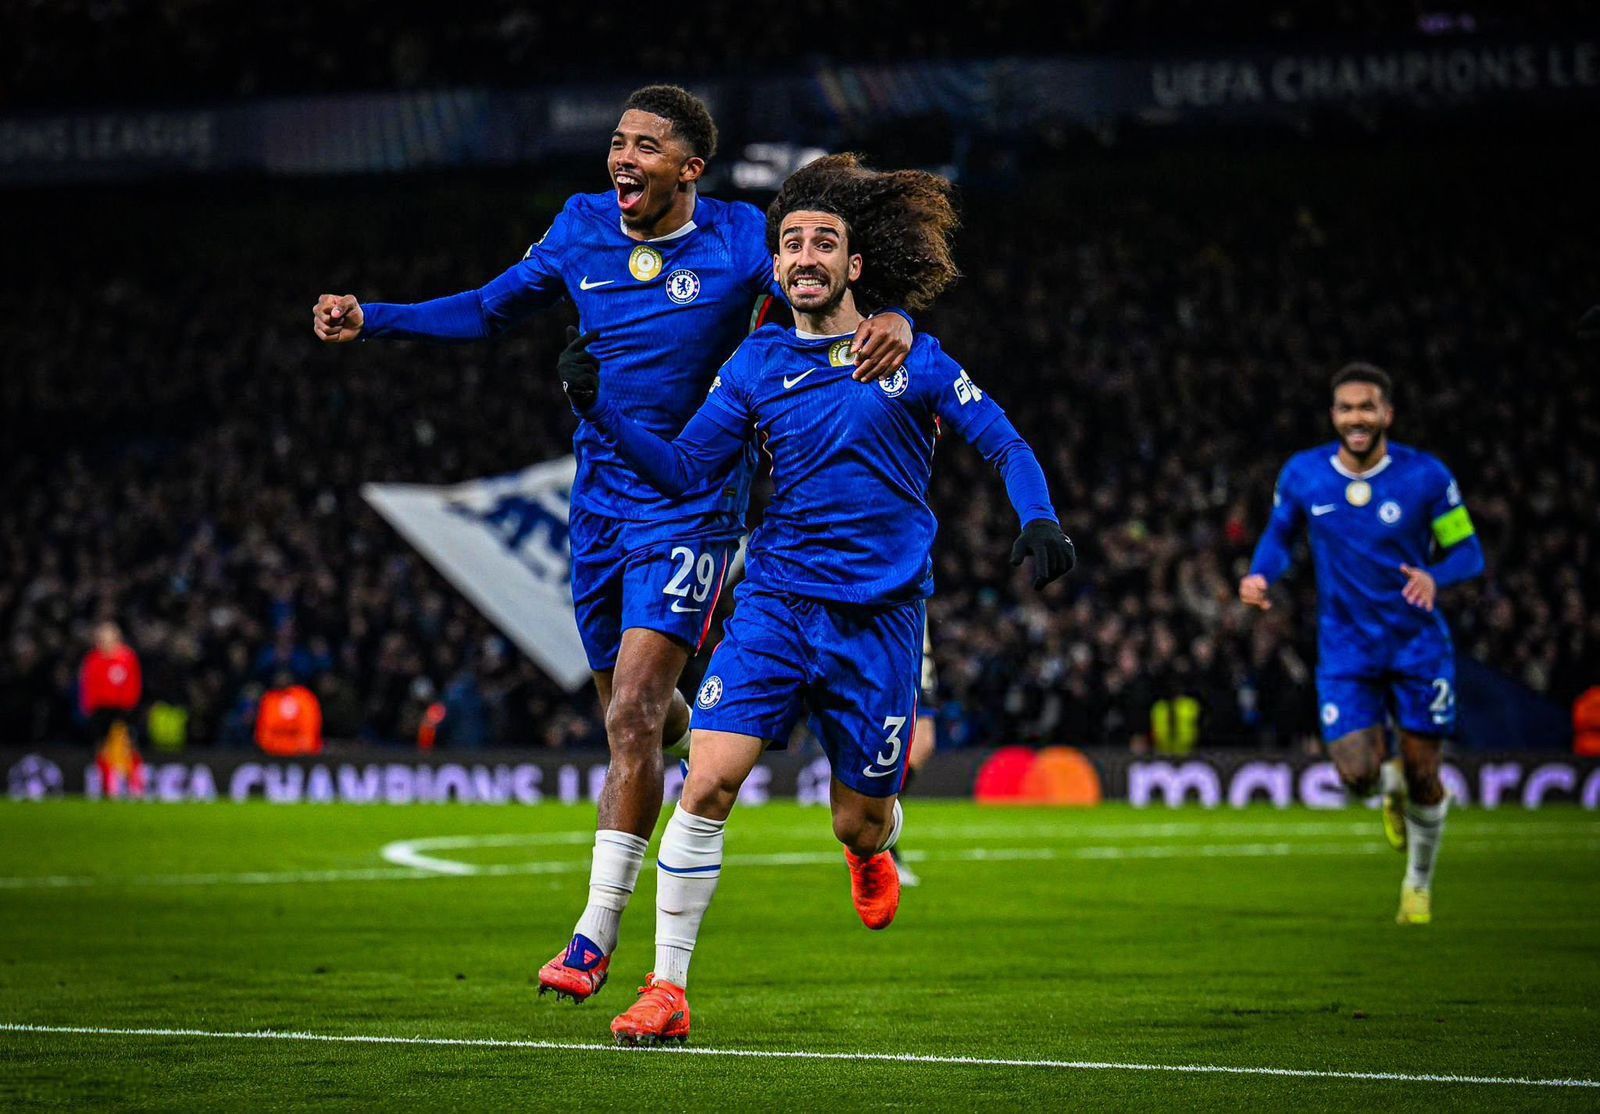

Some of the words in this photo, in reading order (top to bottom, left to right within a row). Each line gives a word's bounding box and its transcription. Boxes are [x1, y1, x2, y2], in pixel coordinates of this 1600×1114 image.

[1151, 60, 1263, 107] UEFA
[1270, 44, 1539, 101] CHAMPIONS
[662, 546, 715, 603] 29
[876, 716, 906, 766] 3
[230, 762, 544, 804] CHAMPIONS
